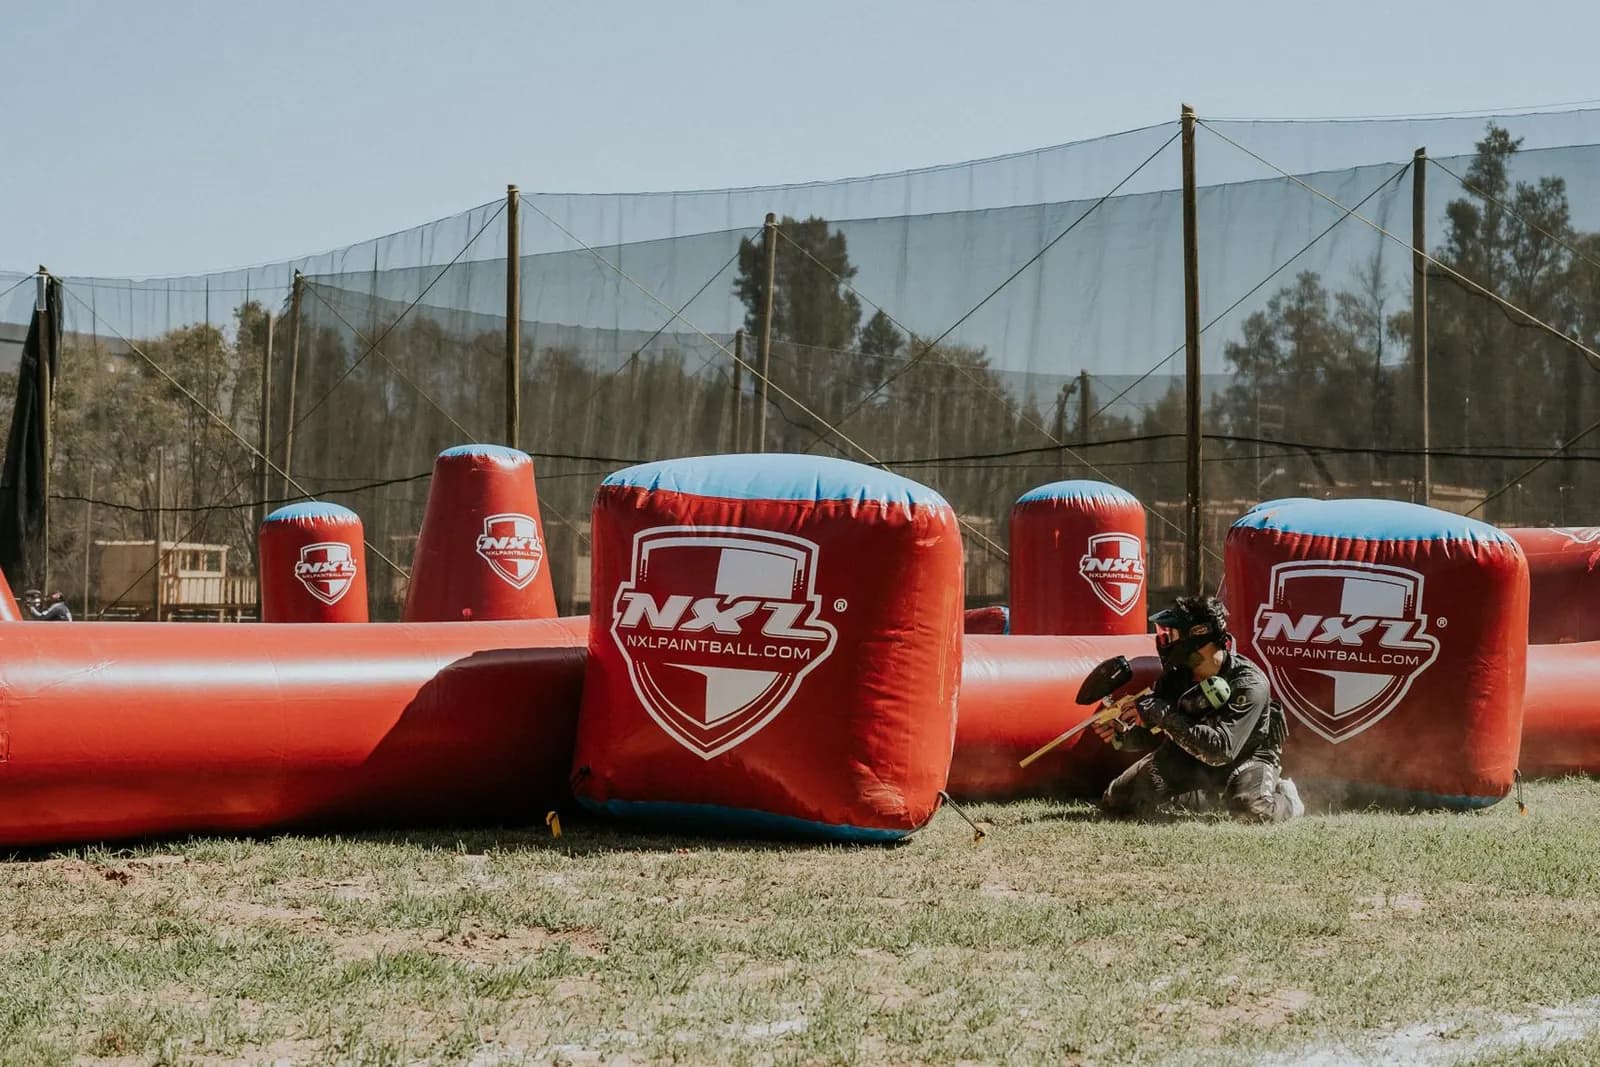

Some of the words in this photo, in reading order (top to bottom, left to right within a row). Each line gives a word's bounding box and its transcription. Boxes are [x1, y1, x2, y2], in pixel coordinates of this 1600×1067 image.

[481, 536, 541, 550] NXL
[298, 561, 354, 573] NXL
[1084, 557, 1143, 573] NXL
[619, 592, 828, 641] NXL
[1259, 612, 1433, 651] NXL
[626, 634, 811, 660] NXLPAINTBALL.COM
[1266, 645, 1419, 665] NXLPAINTBALL.COM
